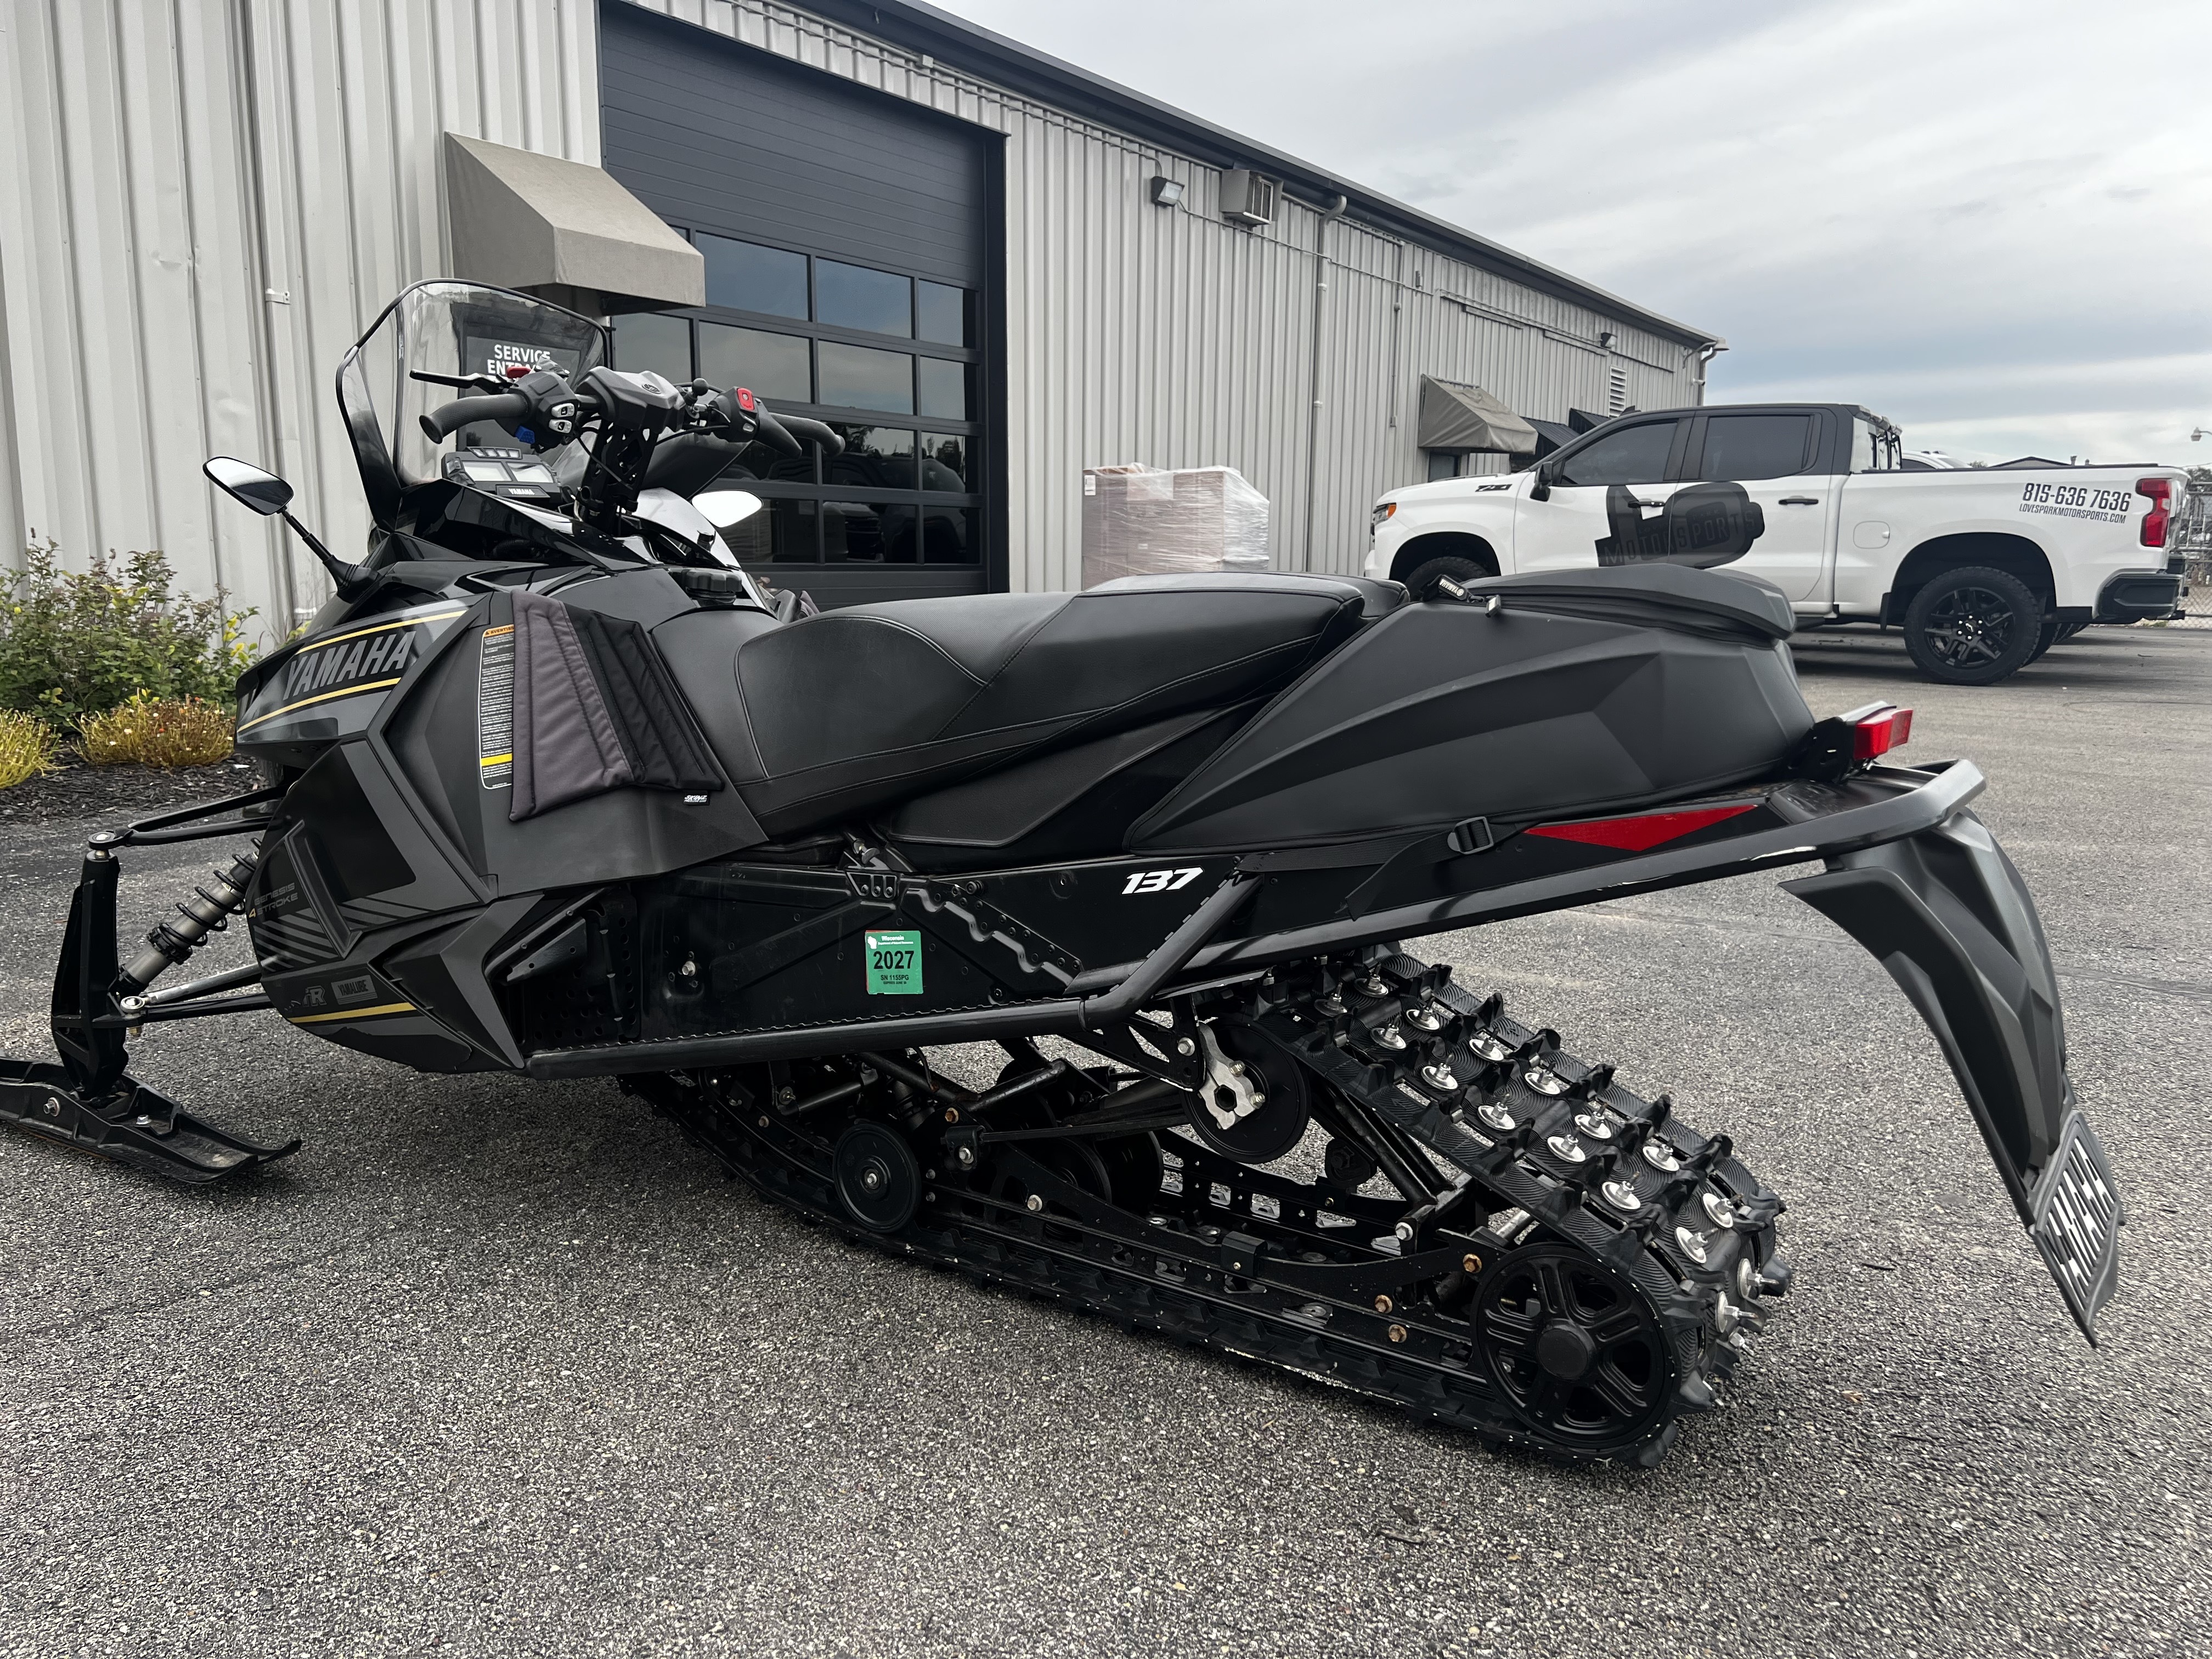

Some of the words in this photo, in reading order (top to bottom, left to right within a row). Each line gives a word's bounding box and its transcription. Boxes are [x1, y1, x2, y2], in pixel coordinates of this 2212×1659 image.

[494, 344, 551, 363] SERVICE
[2023, 483, 2088, 506] 815-636
[2090, 489, 2132, 512] 7636
[2019, 504, 2127, 524] LOVESPARKMOTORSPORTS.COM
[1603, 510, 1757, 565] MOTORSPORTS
[283, 631, 416, 701] YAMAHA
[1121, 867, 1204, 895] 137
[249, 908, 257, 918] 4
[257, 892, 298, 916] STROKE
[873, 951, 915, 969] 2027
[337, 980, 369, 996] YAMALUBE
